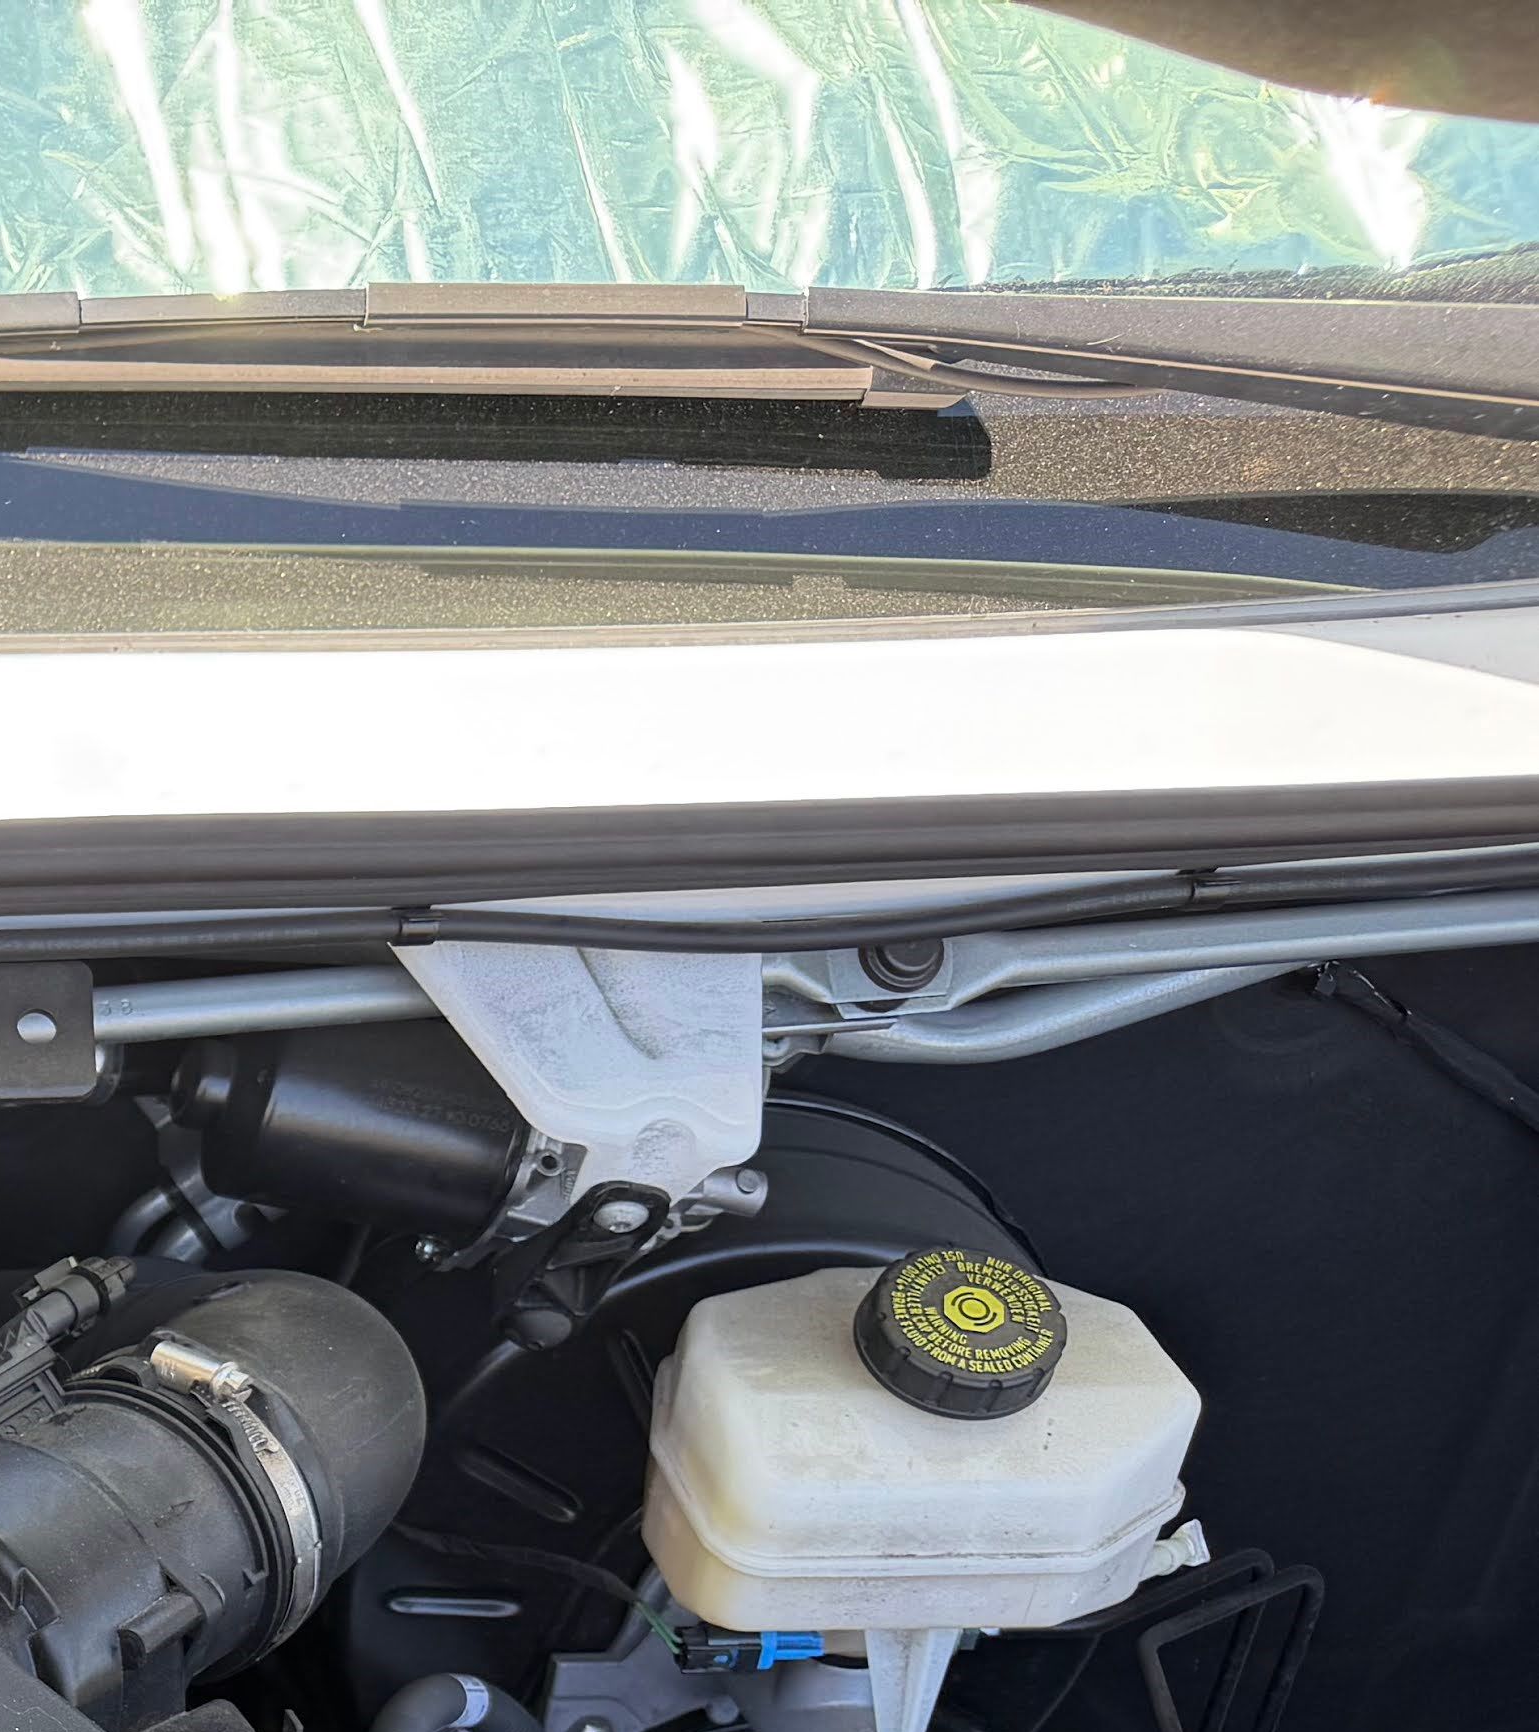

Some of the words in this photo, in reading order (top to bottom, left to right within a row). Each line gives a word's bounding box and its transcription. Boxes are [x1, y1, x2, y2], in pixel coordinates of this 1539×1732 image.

[915, 1253, 941, 1267] ONLY
[942, 1251, 964, 1262] USE
[914, 1264, 946, 1286] CLEAN
[986, 1257, 1013, 1272] NUR
[1012, 1270, 1052, 1312] ORIGINAL
[891, 1291, 909, 1320] BRAKE
[907, 1283, 924, 1315] FILLER
[967, 1273, 1025, 1323] VERWENDEN
[900, 1320, 927, 1347] FLUID
[911, 1316, 934, 1333] CAP
[923, 1306, 967, 1345] WARNING
[923, 1343, 956, 1365] FROM
[927, 1331, 973, 1358] BEFORE
[975, 1336, 1032, 1360] REMOVING
[1010, 1328, 1054, 1368] CONTAINER
[956, 1358, 966, 1368] A
[968, 1359, 1013, 1373] SEALED
